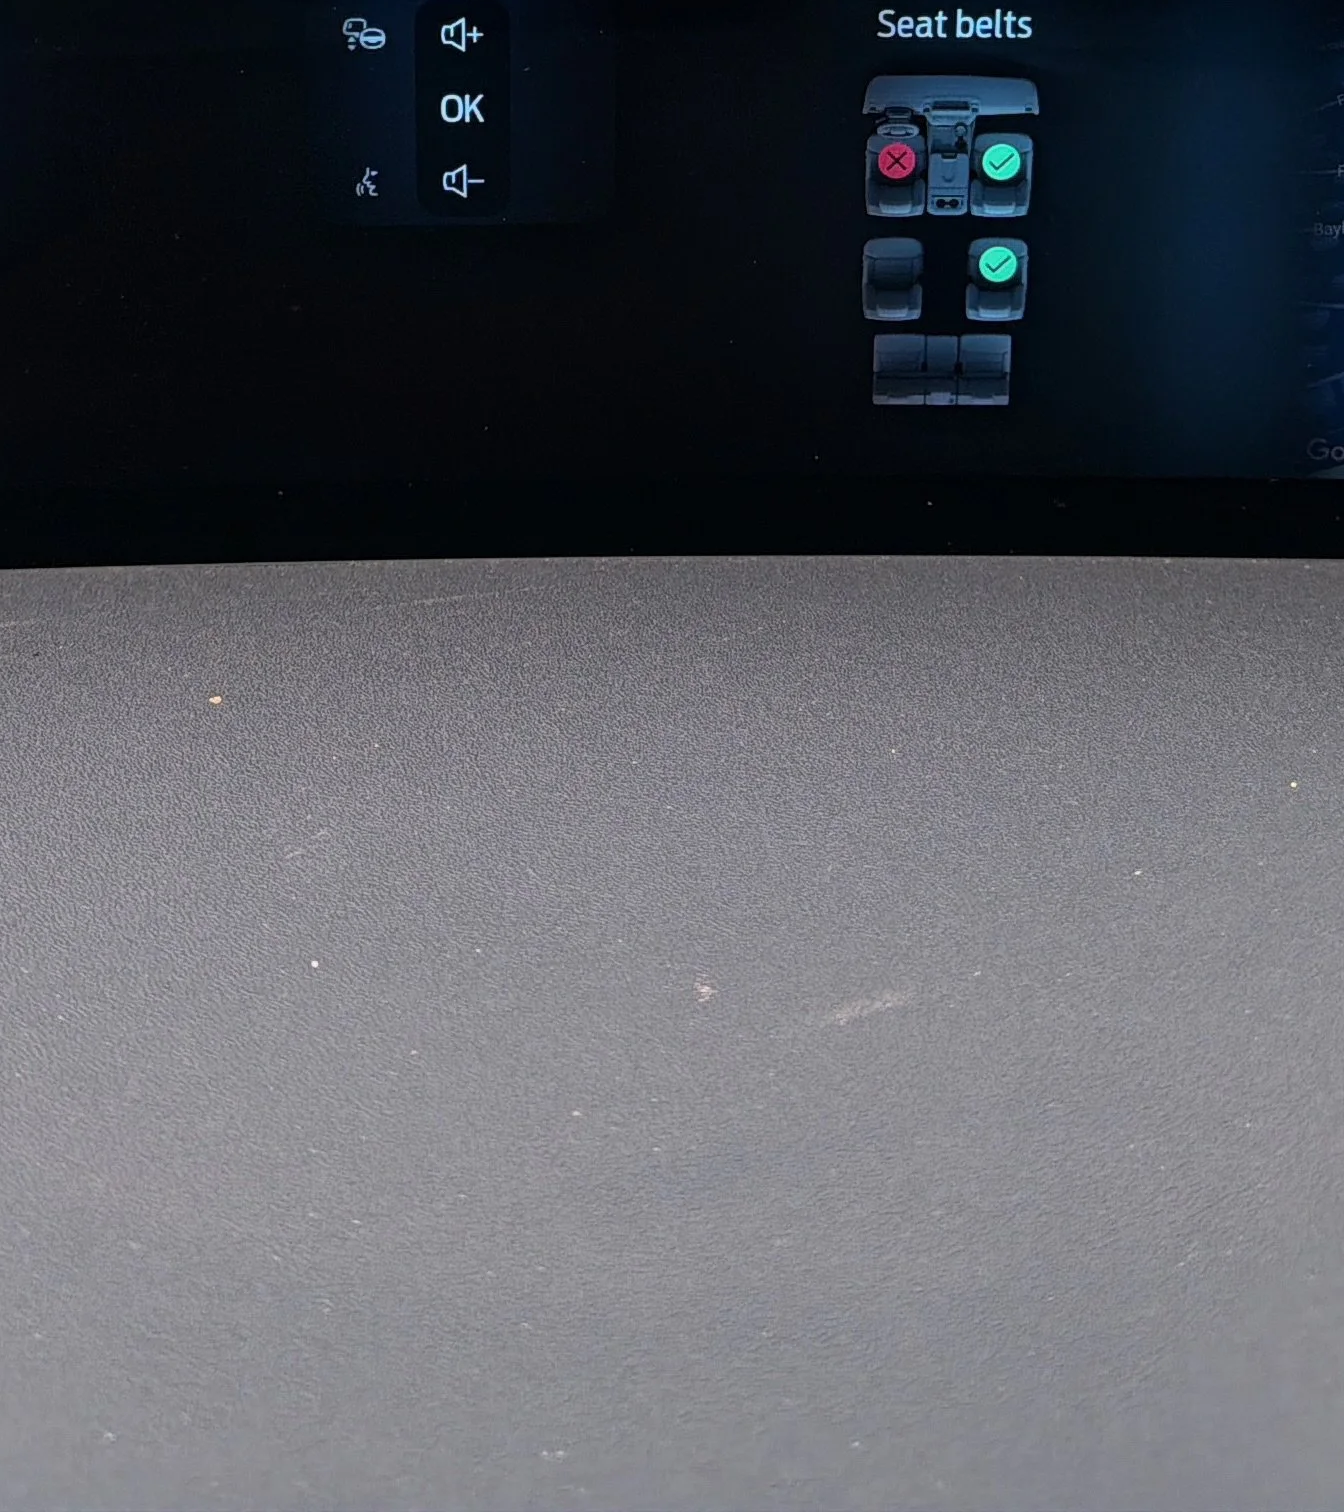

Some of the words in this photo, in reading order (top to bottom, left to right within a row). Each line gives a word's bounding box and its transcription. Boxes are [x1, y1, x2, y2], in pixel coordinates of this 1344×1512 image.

[876, 9, 948, 40] Seat
[954, 7, 1034, 40] belts
[440, 93, 486, 123] OK
